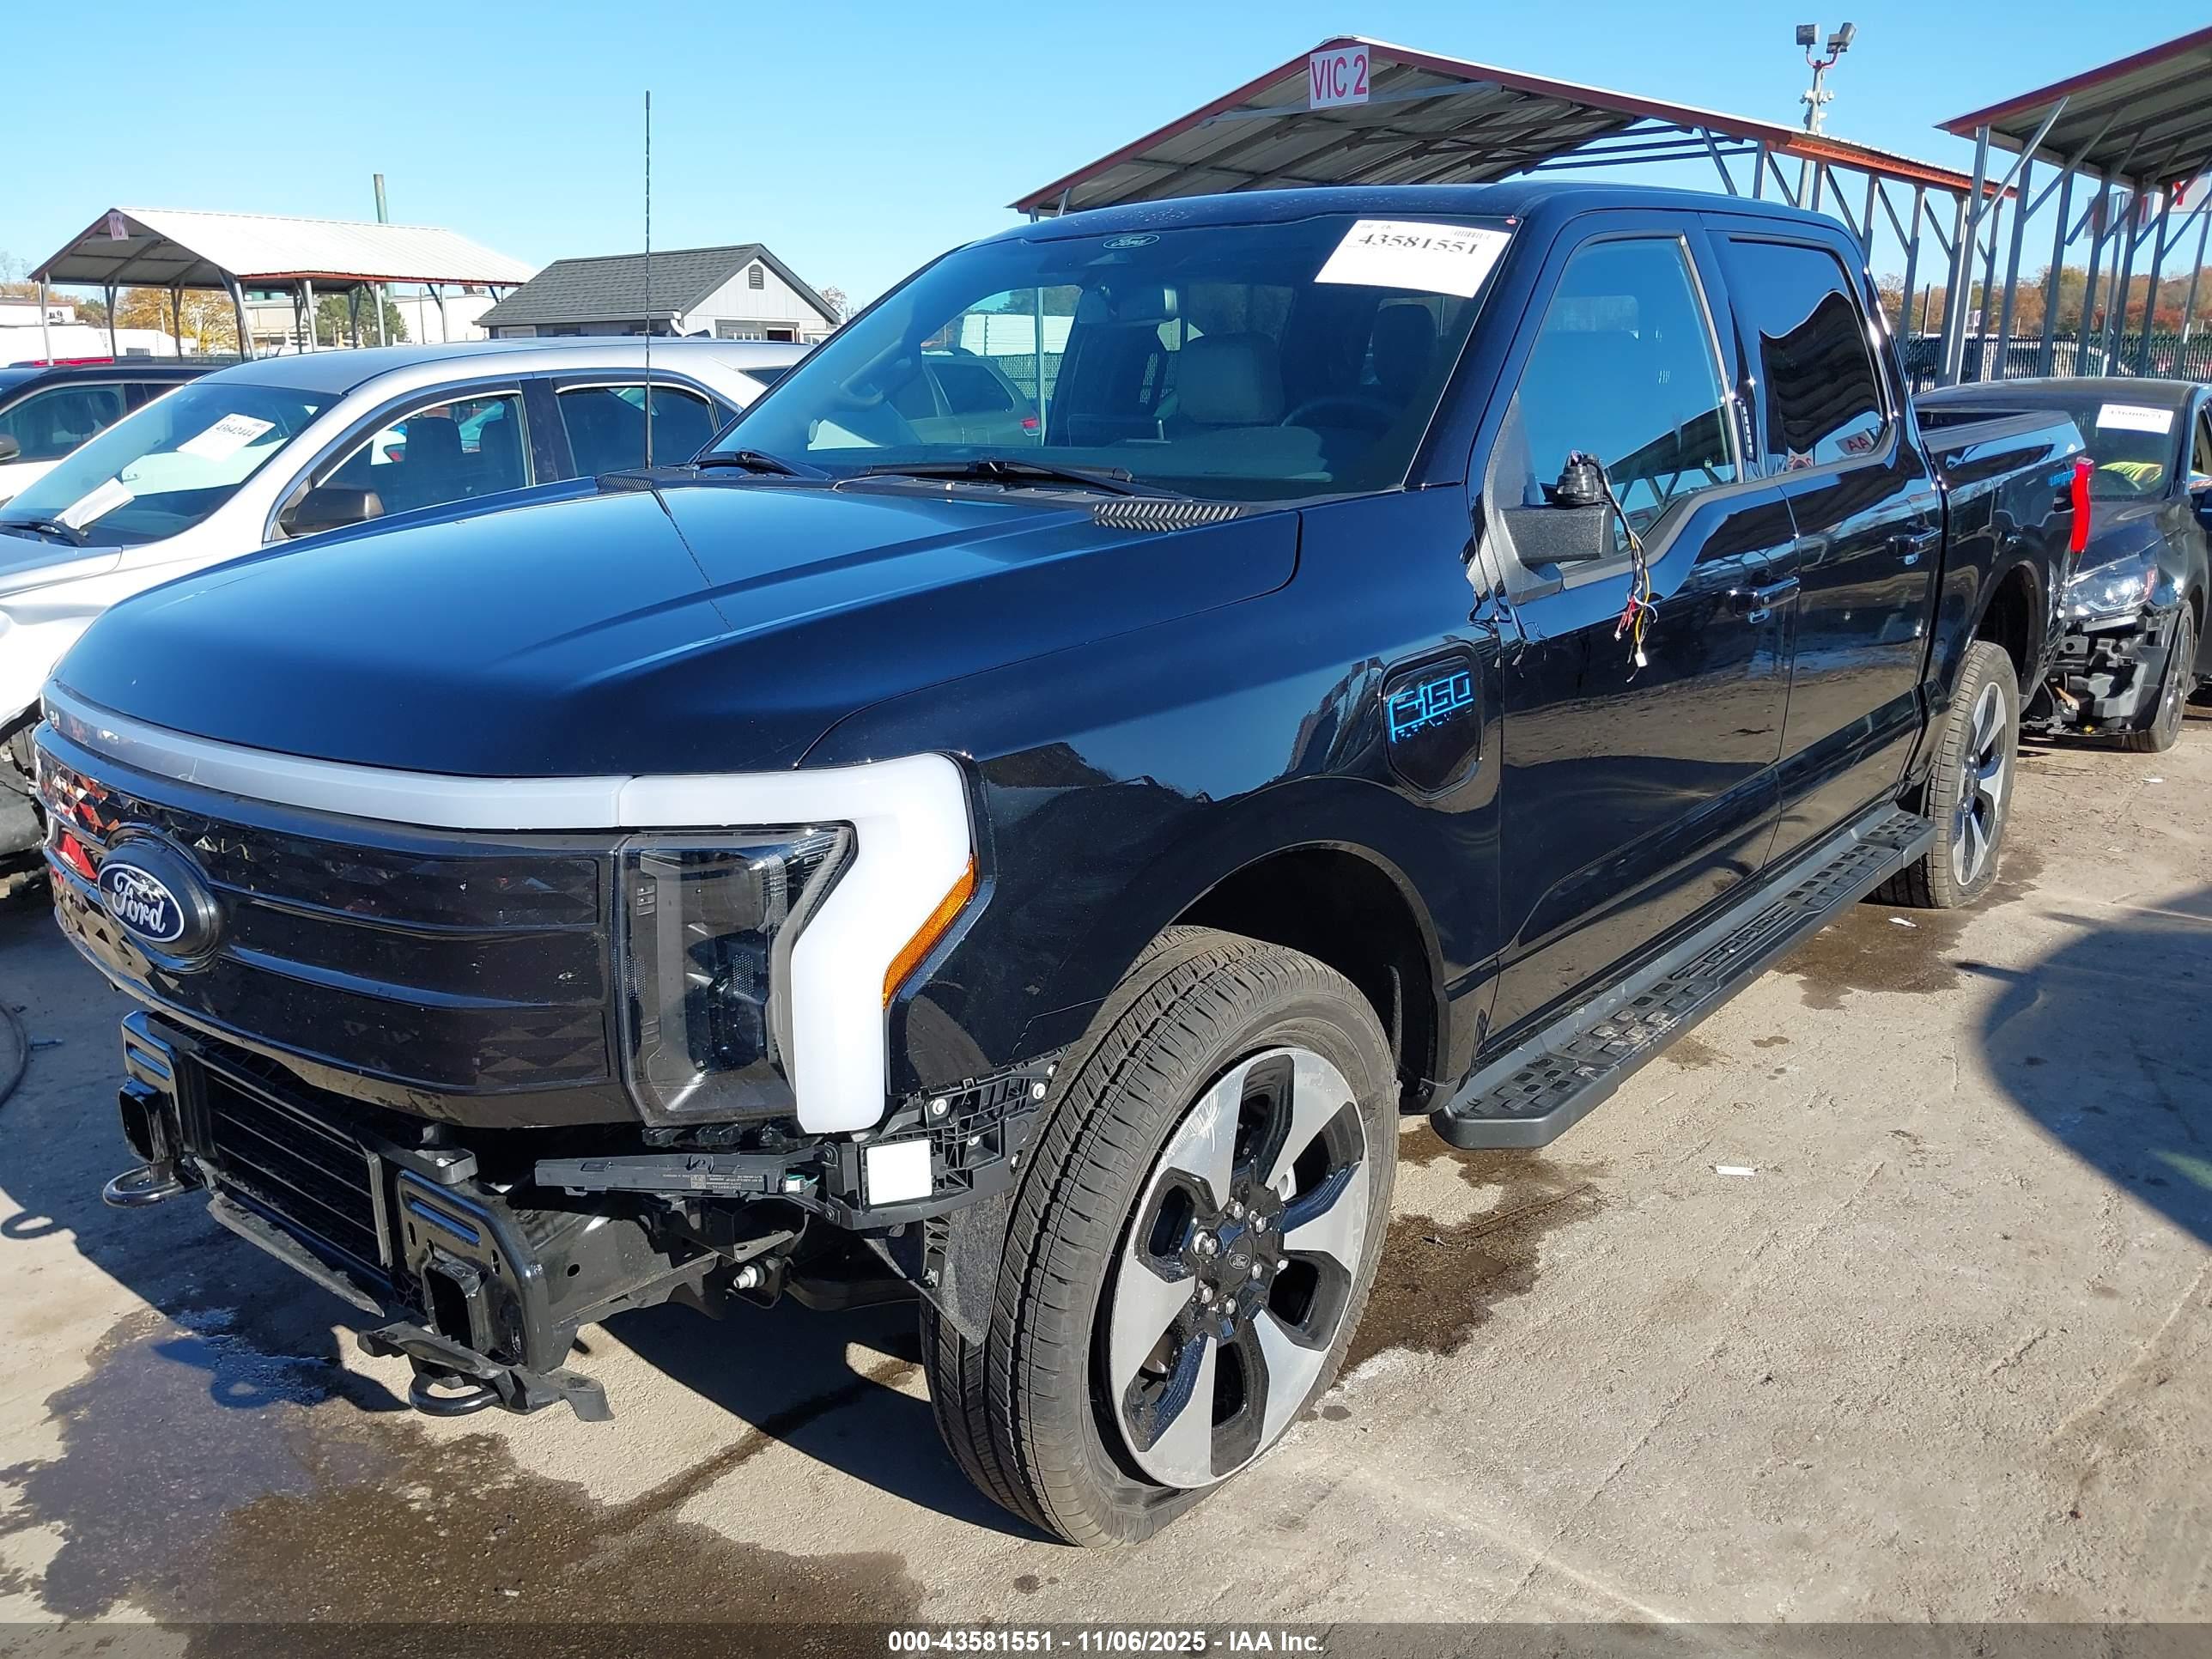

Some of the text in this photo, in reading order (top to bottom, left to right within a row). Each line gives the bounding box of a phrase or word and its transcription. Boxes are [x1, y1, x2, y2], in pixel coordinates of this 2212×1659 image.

[1311, 54, 1367, 100] VIC 2
[1358, 234, 1479, 255] 43581551
[112, 872, 167, 933] Ford
